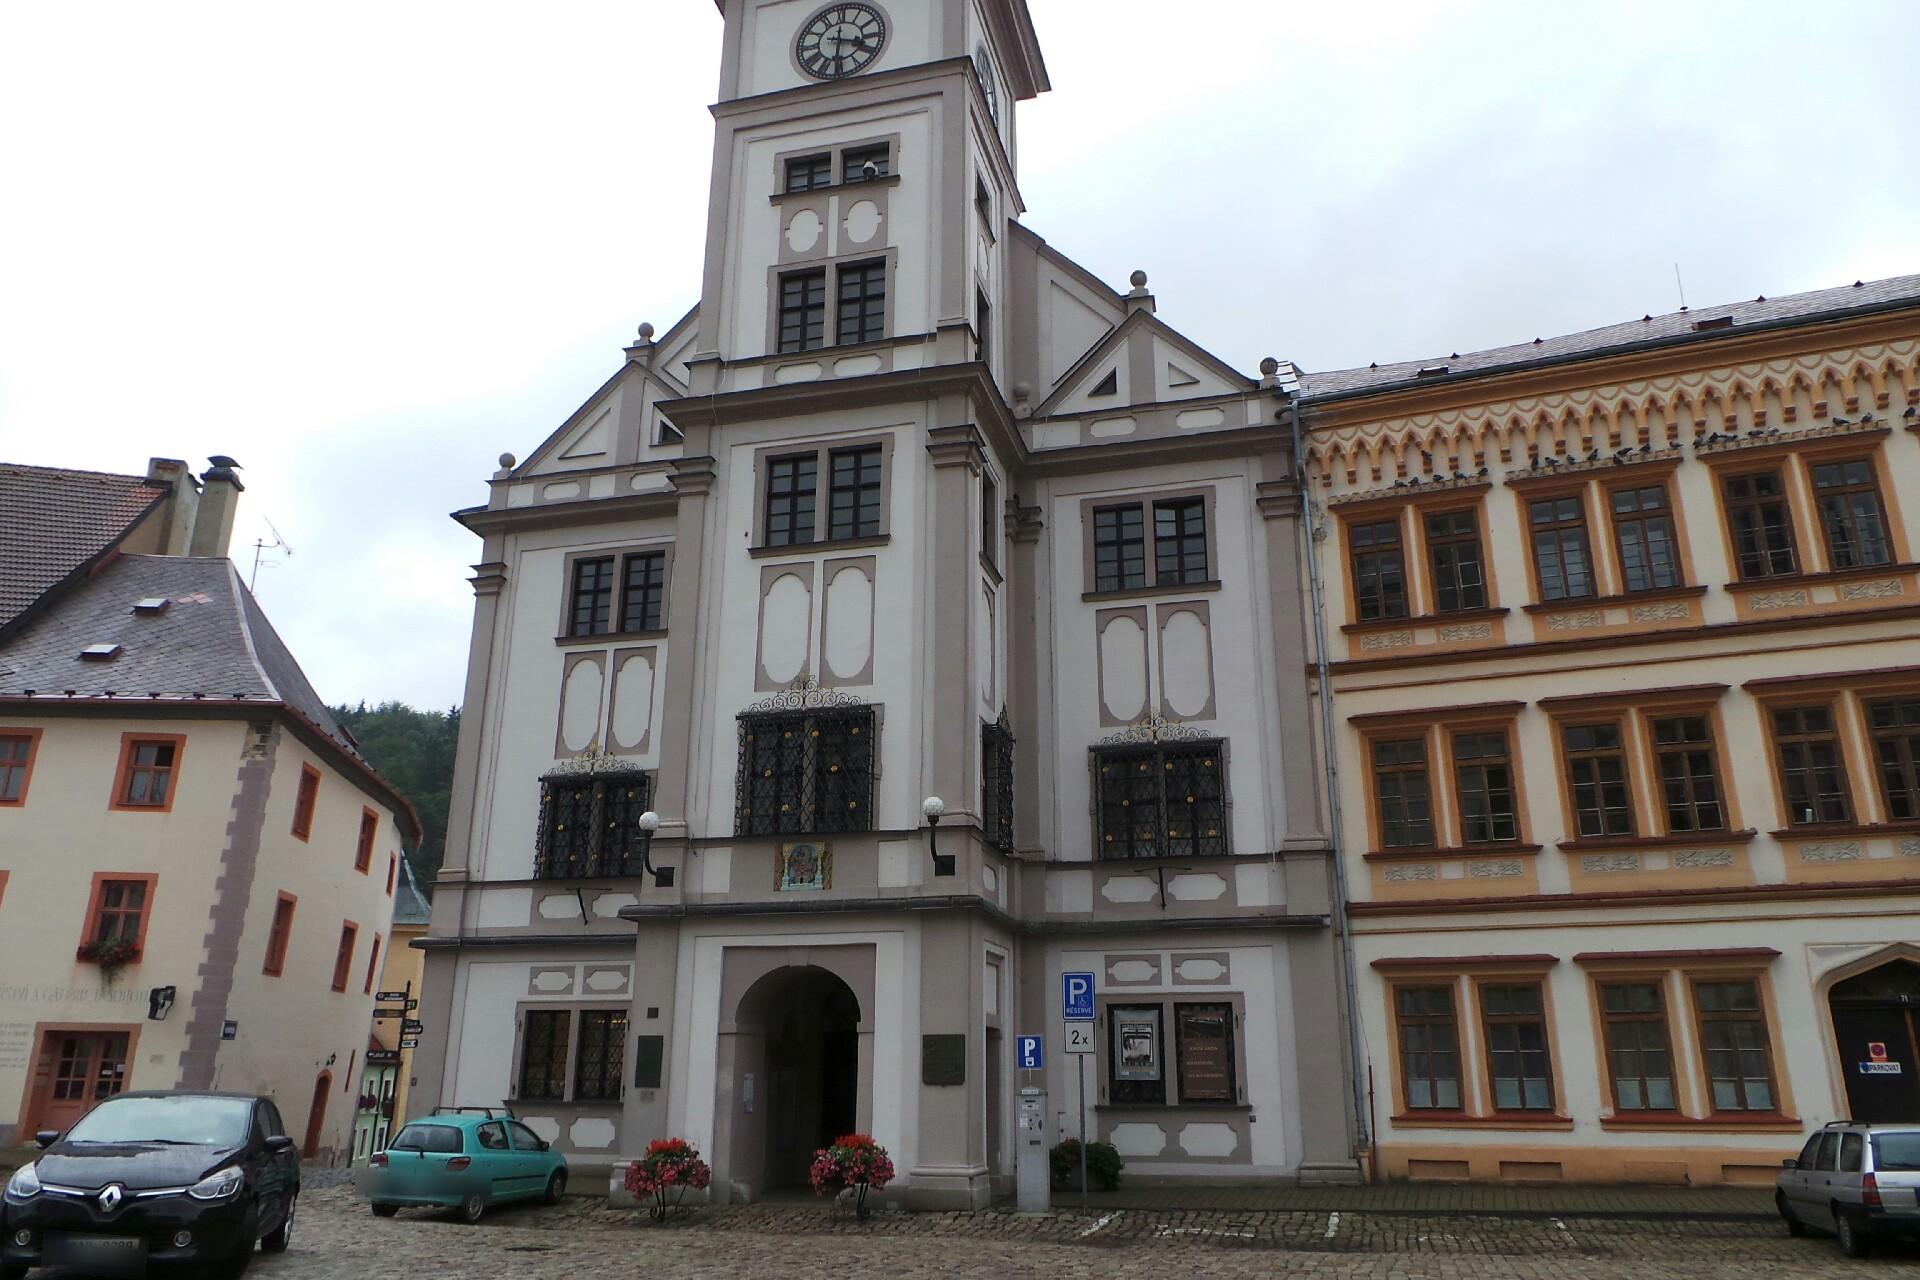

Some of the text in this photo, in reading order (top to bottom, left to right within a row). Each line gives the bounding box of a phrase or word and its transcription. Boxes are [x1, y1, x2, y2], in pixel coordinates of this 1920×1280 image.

[1070, 979, 1088, 1005] P
[1025, 1039, 1036, 1057] P
[1869, 1064, 1900, 1072] PARKOVAT
